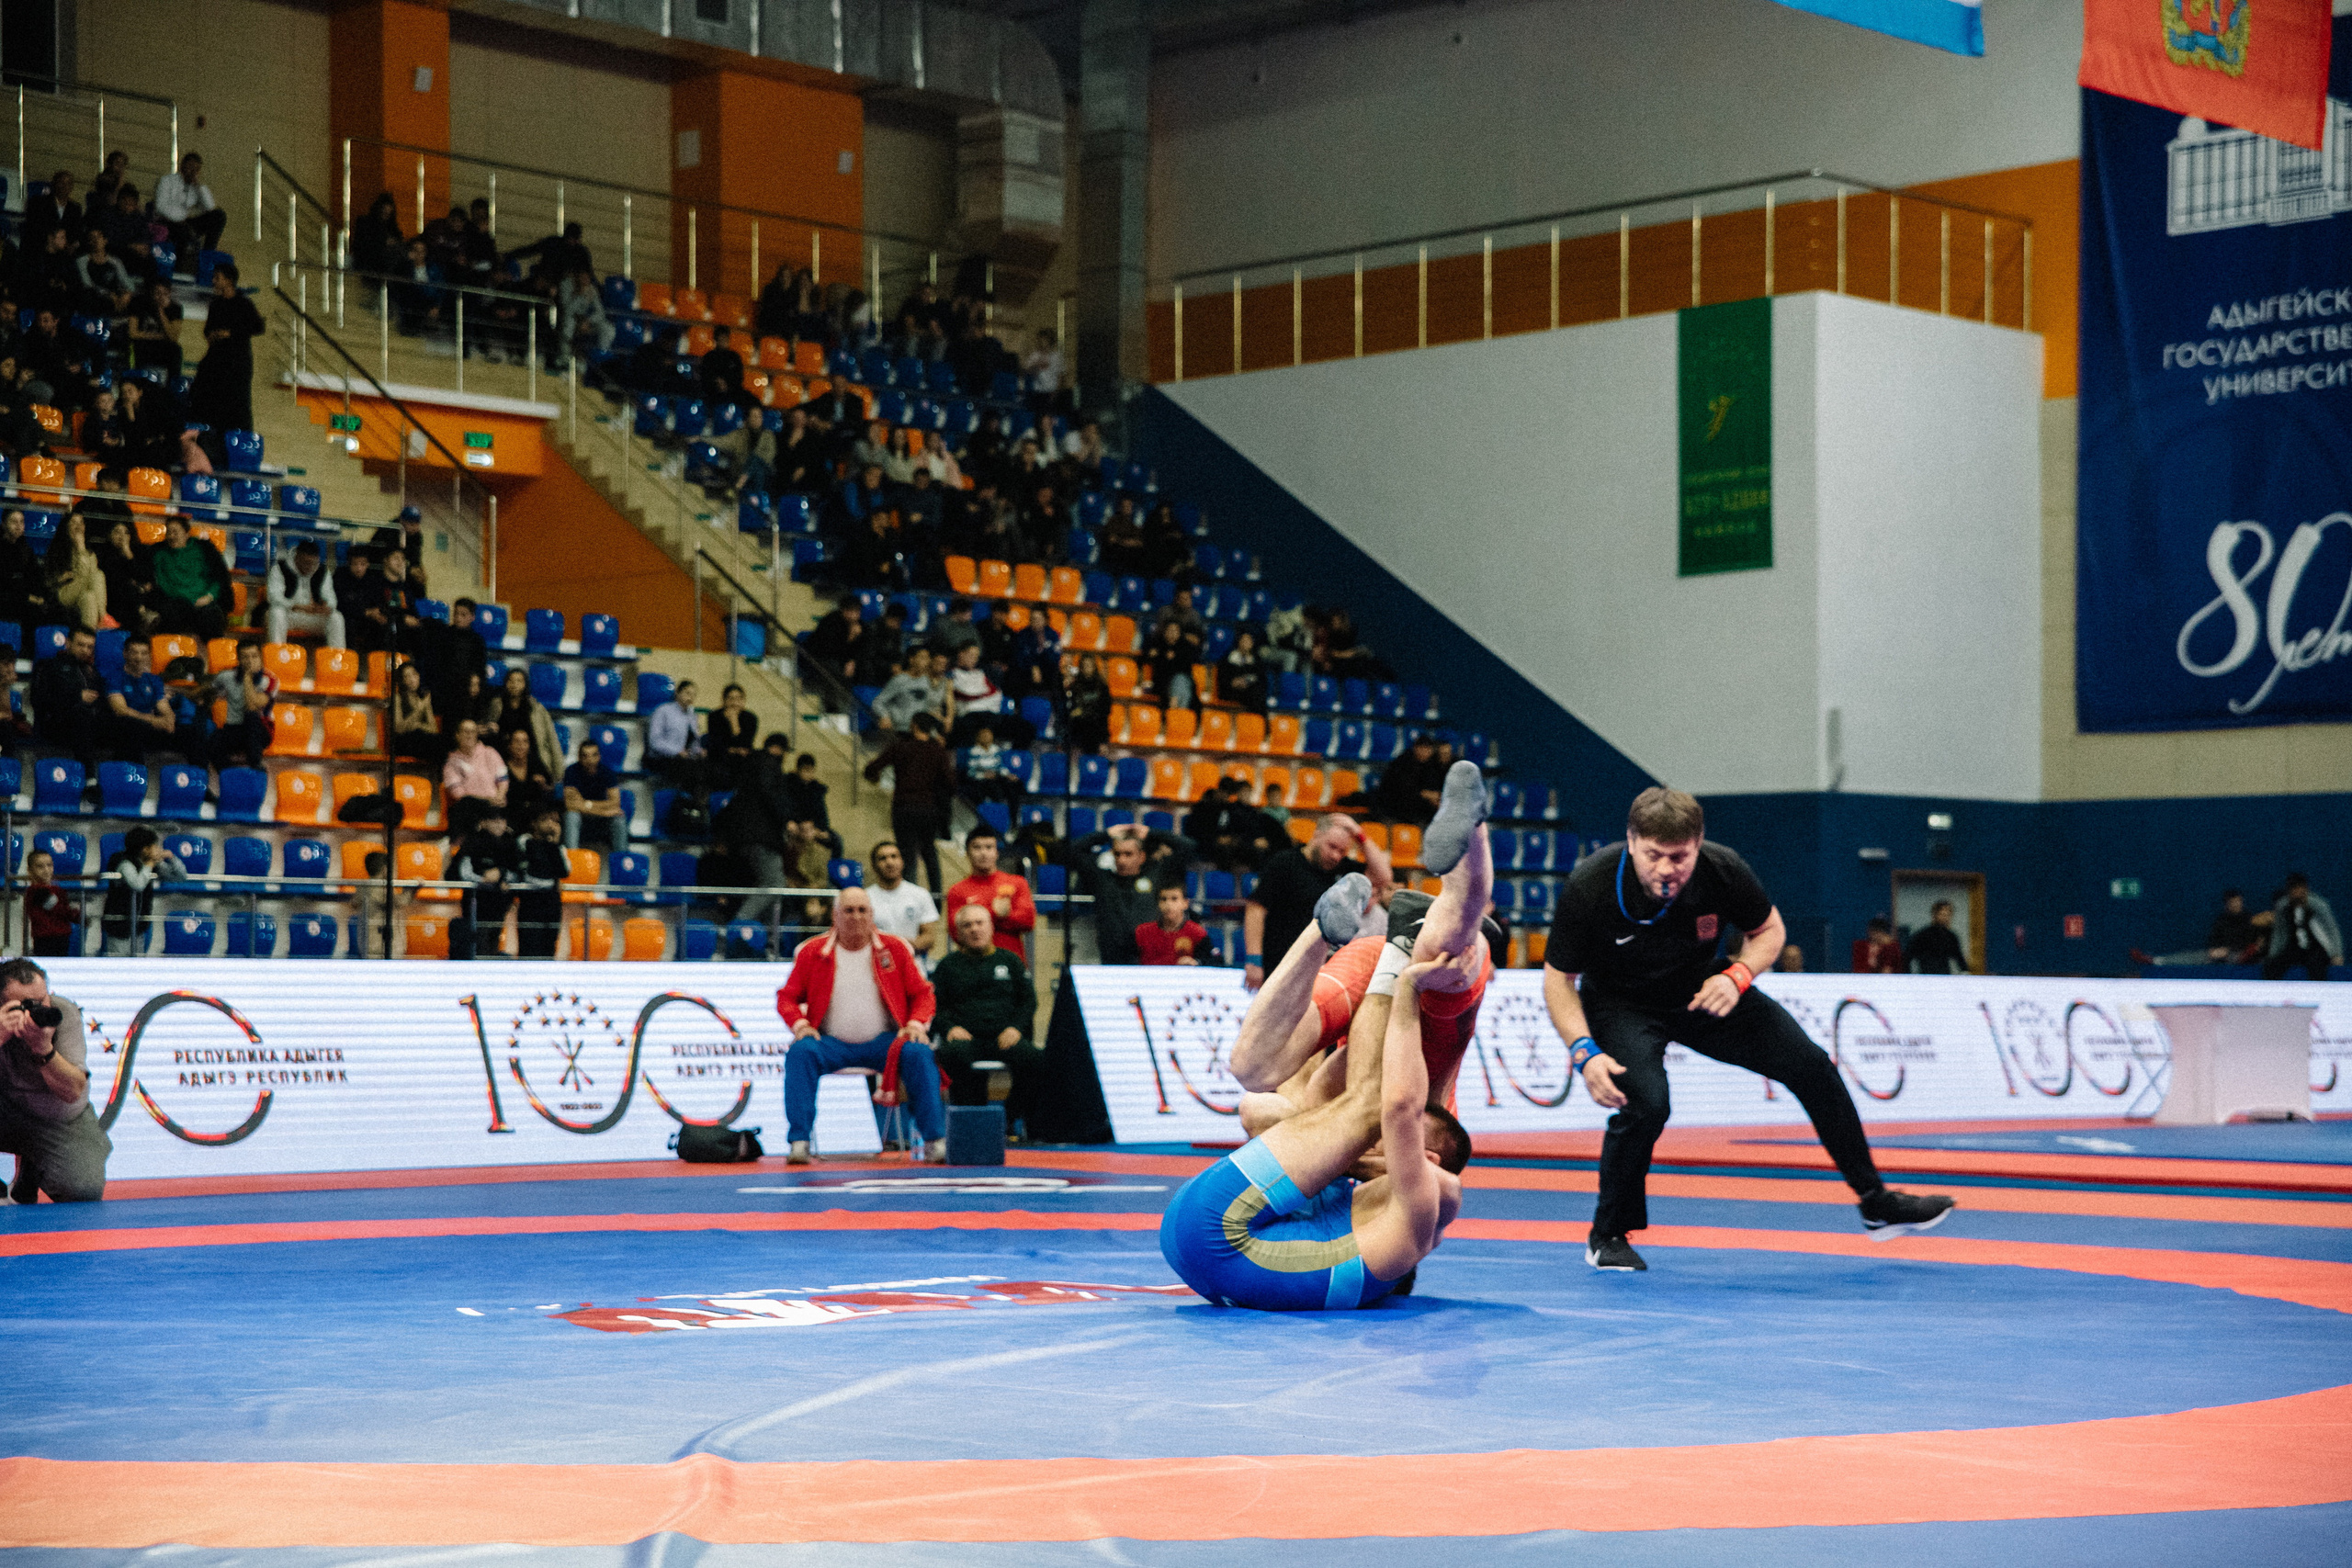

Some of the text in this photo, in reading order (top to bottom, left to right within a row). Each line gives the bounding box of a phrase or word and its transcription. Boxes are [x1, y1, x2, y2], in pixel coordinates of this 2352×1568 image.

[2207, 288, 2352, 331] АДЫГЕЙСК
[2163, 323, 2352, 370] ГОСУДАРСТВЕ
[174, 1048, 345, 1064] РЕСПУБЛИКА АДЫГЕЯ
[245, 1070, 348, 1085] РЕСПУБЛИК
